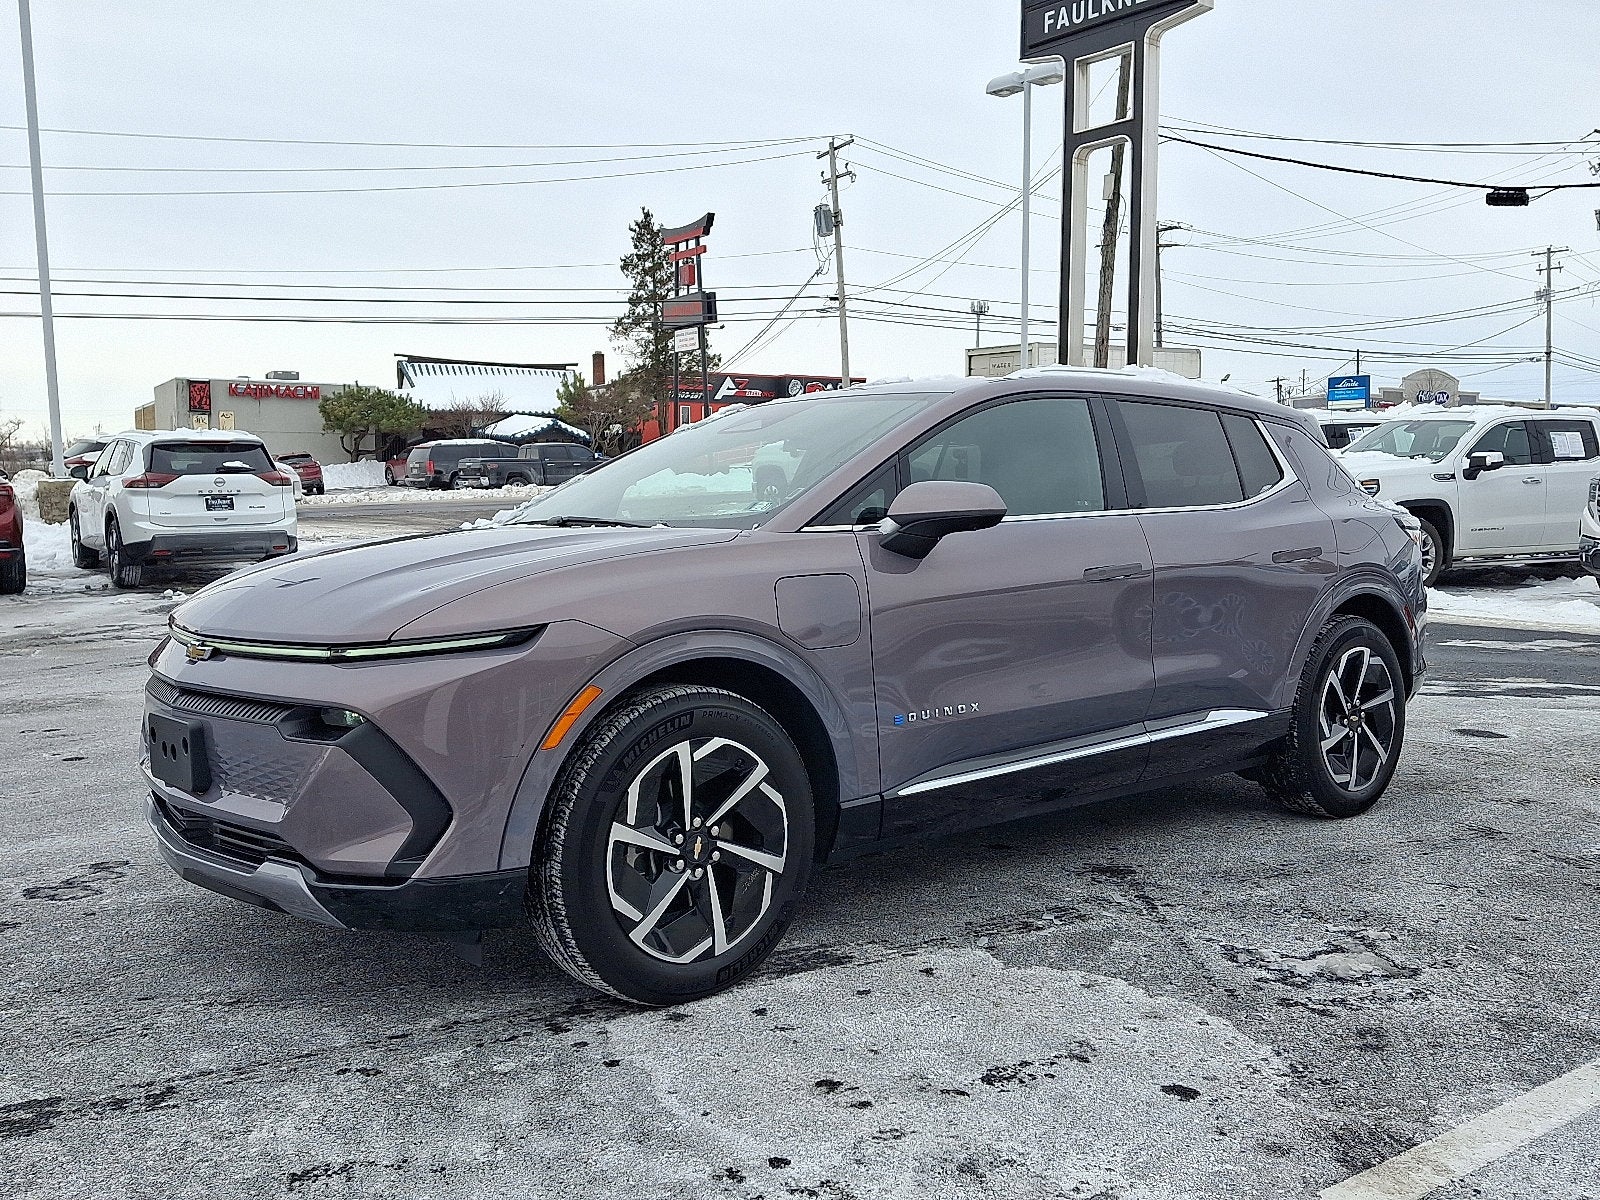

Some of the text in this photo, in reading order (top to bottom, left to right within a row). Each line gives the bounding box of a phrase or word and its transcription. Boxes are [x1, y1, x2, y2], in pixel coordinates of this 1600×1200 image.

[1043, 0, 1148, 33] FAULKN
[228, 383, 320, 400] KAJIMACHI
[1335, 379, 1360, 388] Linde
[1436, 392, 1448, 402] TAX
[701, 710, 741, 721] PRIMACY
[893, 702, 980, 726] EQUINOX
[622, 711, 693, 767] MICHELIN
